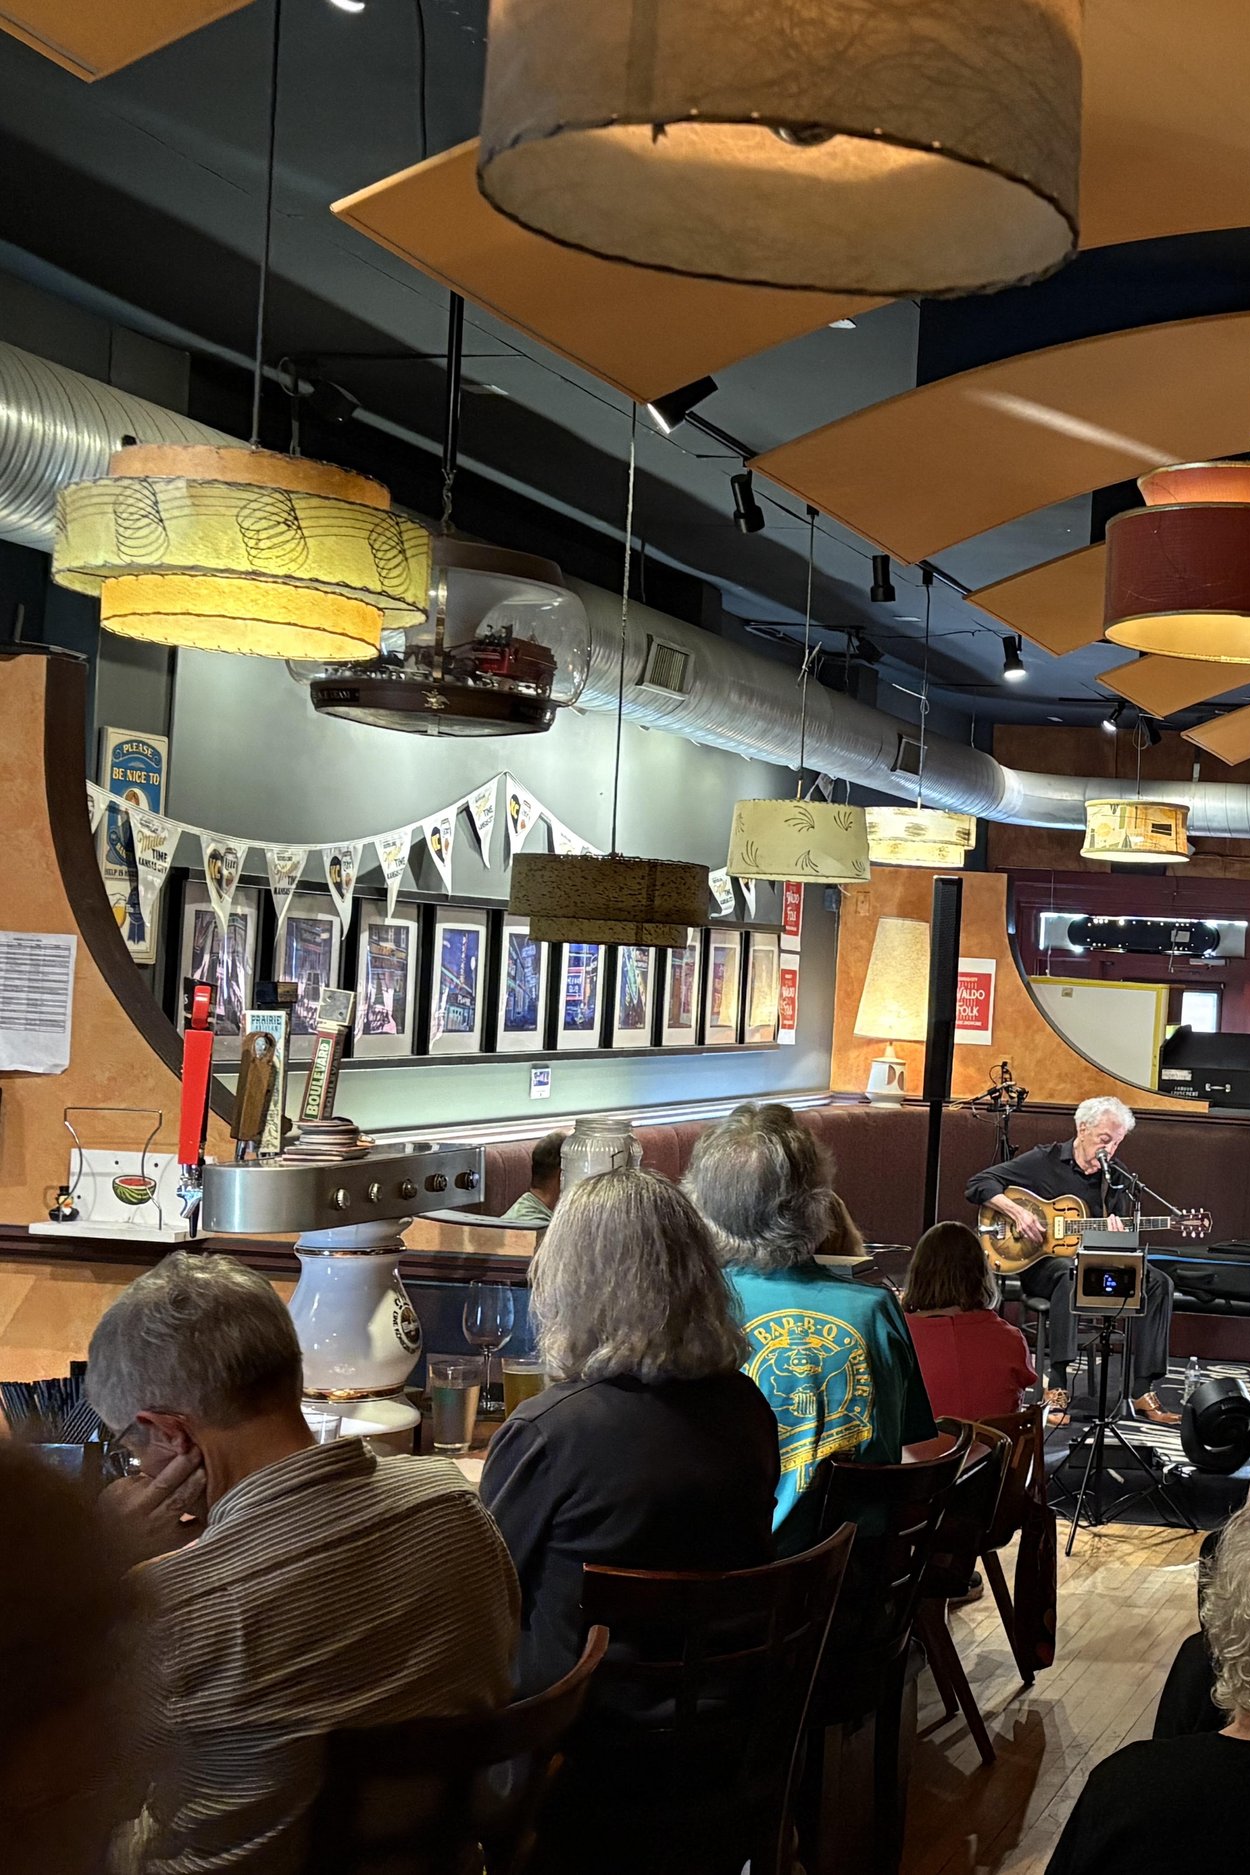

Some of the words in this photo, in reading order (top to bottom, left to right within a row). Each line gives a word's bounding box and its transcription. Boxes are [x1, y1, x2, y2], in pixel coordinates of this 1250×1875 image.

[123, 743, 153, 758] PLEASE
[113, 767, 125, 780] BE
[126, 769, 147, 784] NICE
[149, 772, 160, 785] TO
[152, 849, 168, 863] TIME
[251, 1015, 282, 1025] PRAIRIE
[306, 1043, 330, 1115] BOULEVARD
[849, 1349, 871, 1397] BEER
